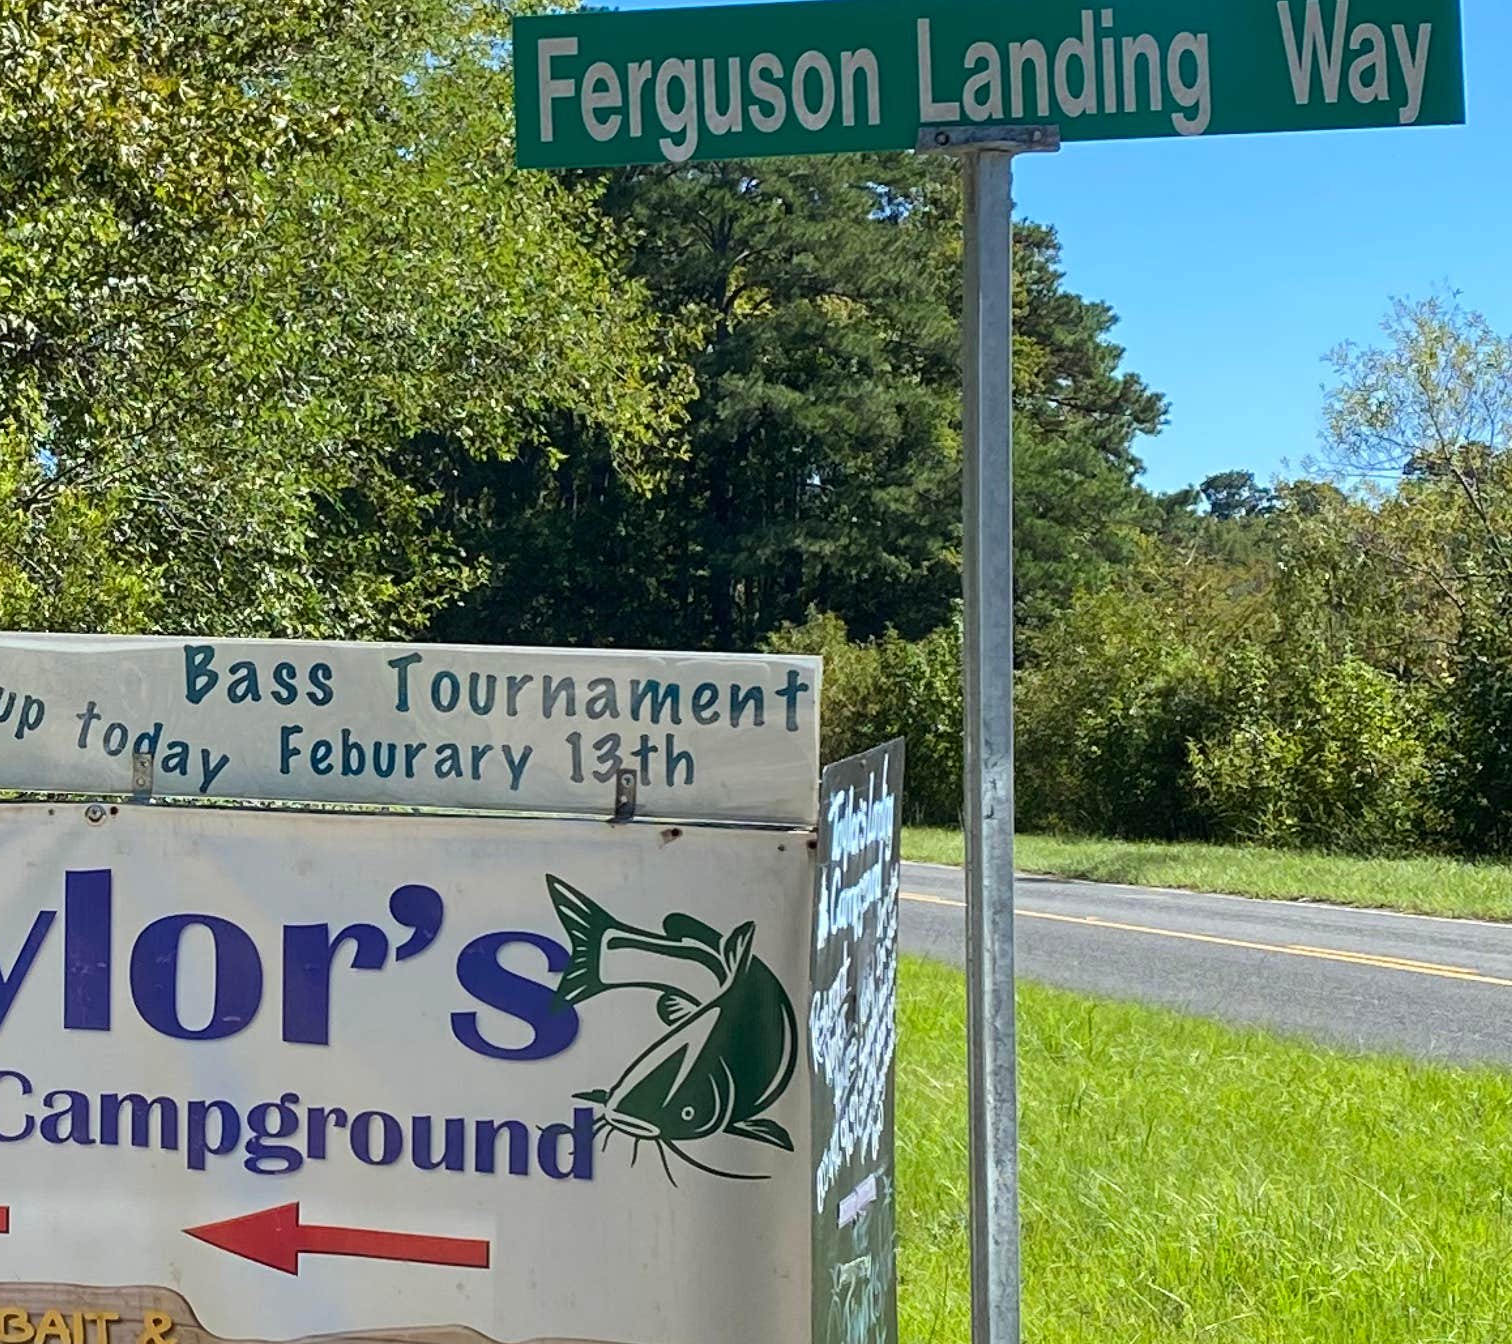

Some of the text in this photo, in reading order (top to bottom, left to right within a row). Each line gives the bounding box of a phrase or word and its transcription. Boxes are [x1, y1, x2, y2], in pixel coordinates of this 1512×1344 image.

[537, 36, 881, 163] Ferguson
[916, 9, 1212, 136] Landing
[183, 644, 810, 732] Bass Tournament
[75, 701, 230, 793] today
[278, 724, 695, 791] Feburary 13th
